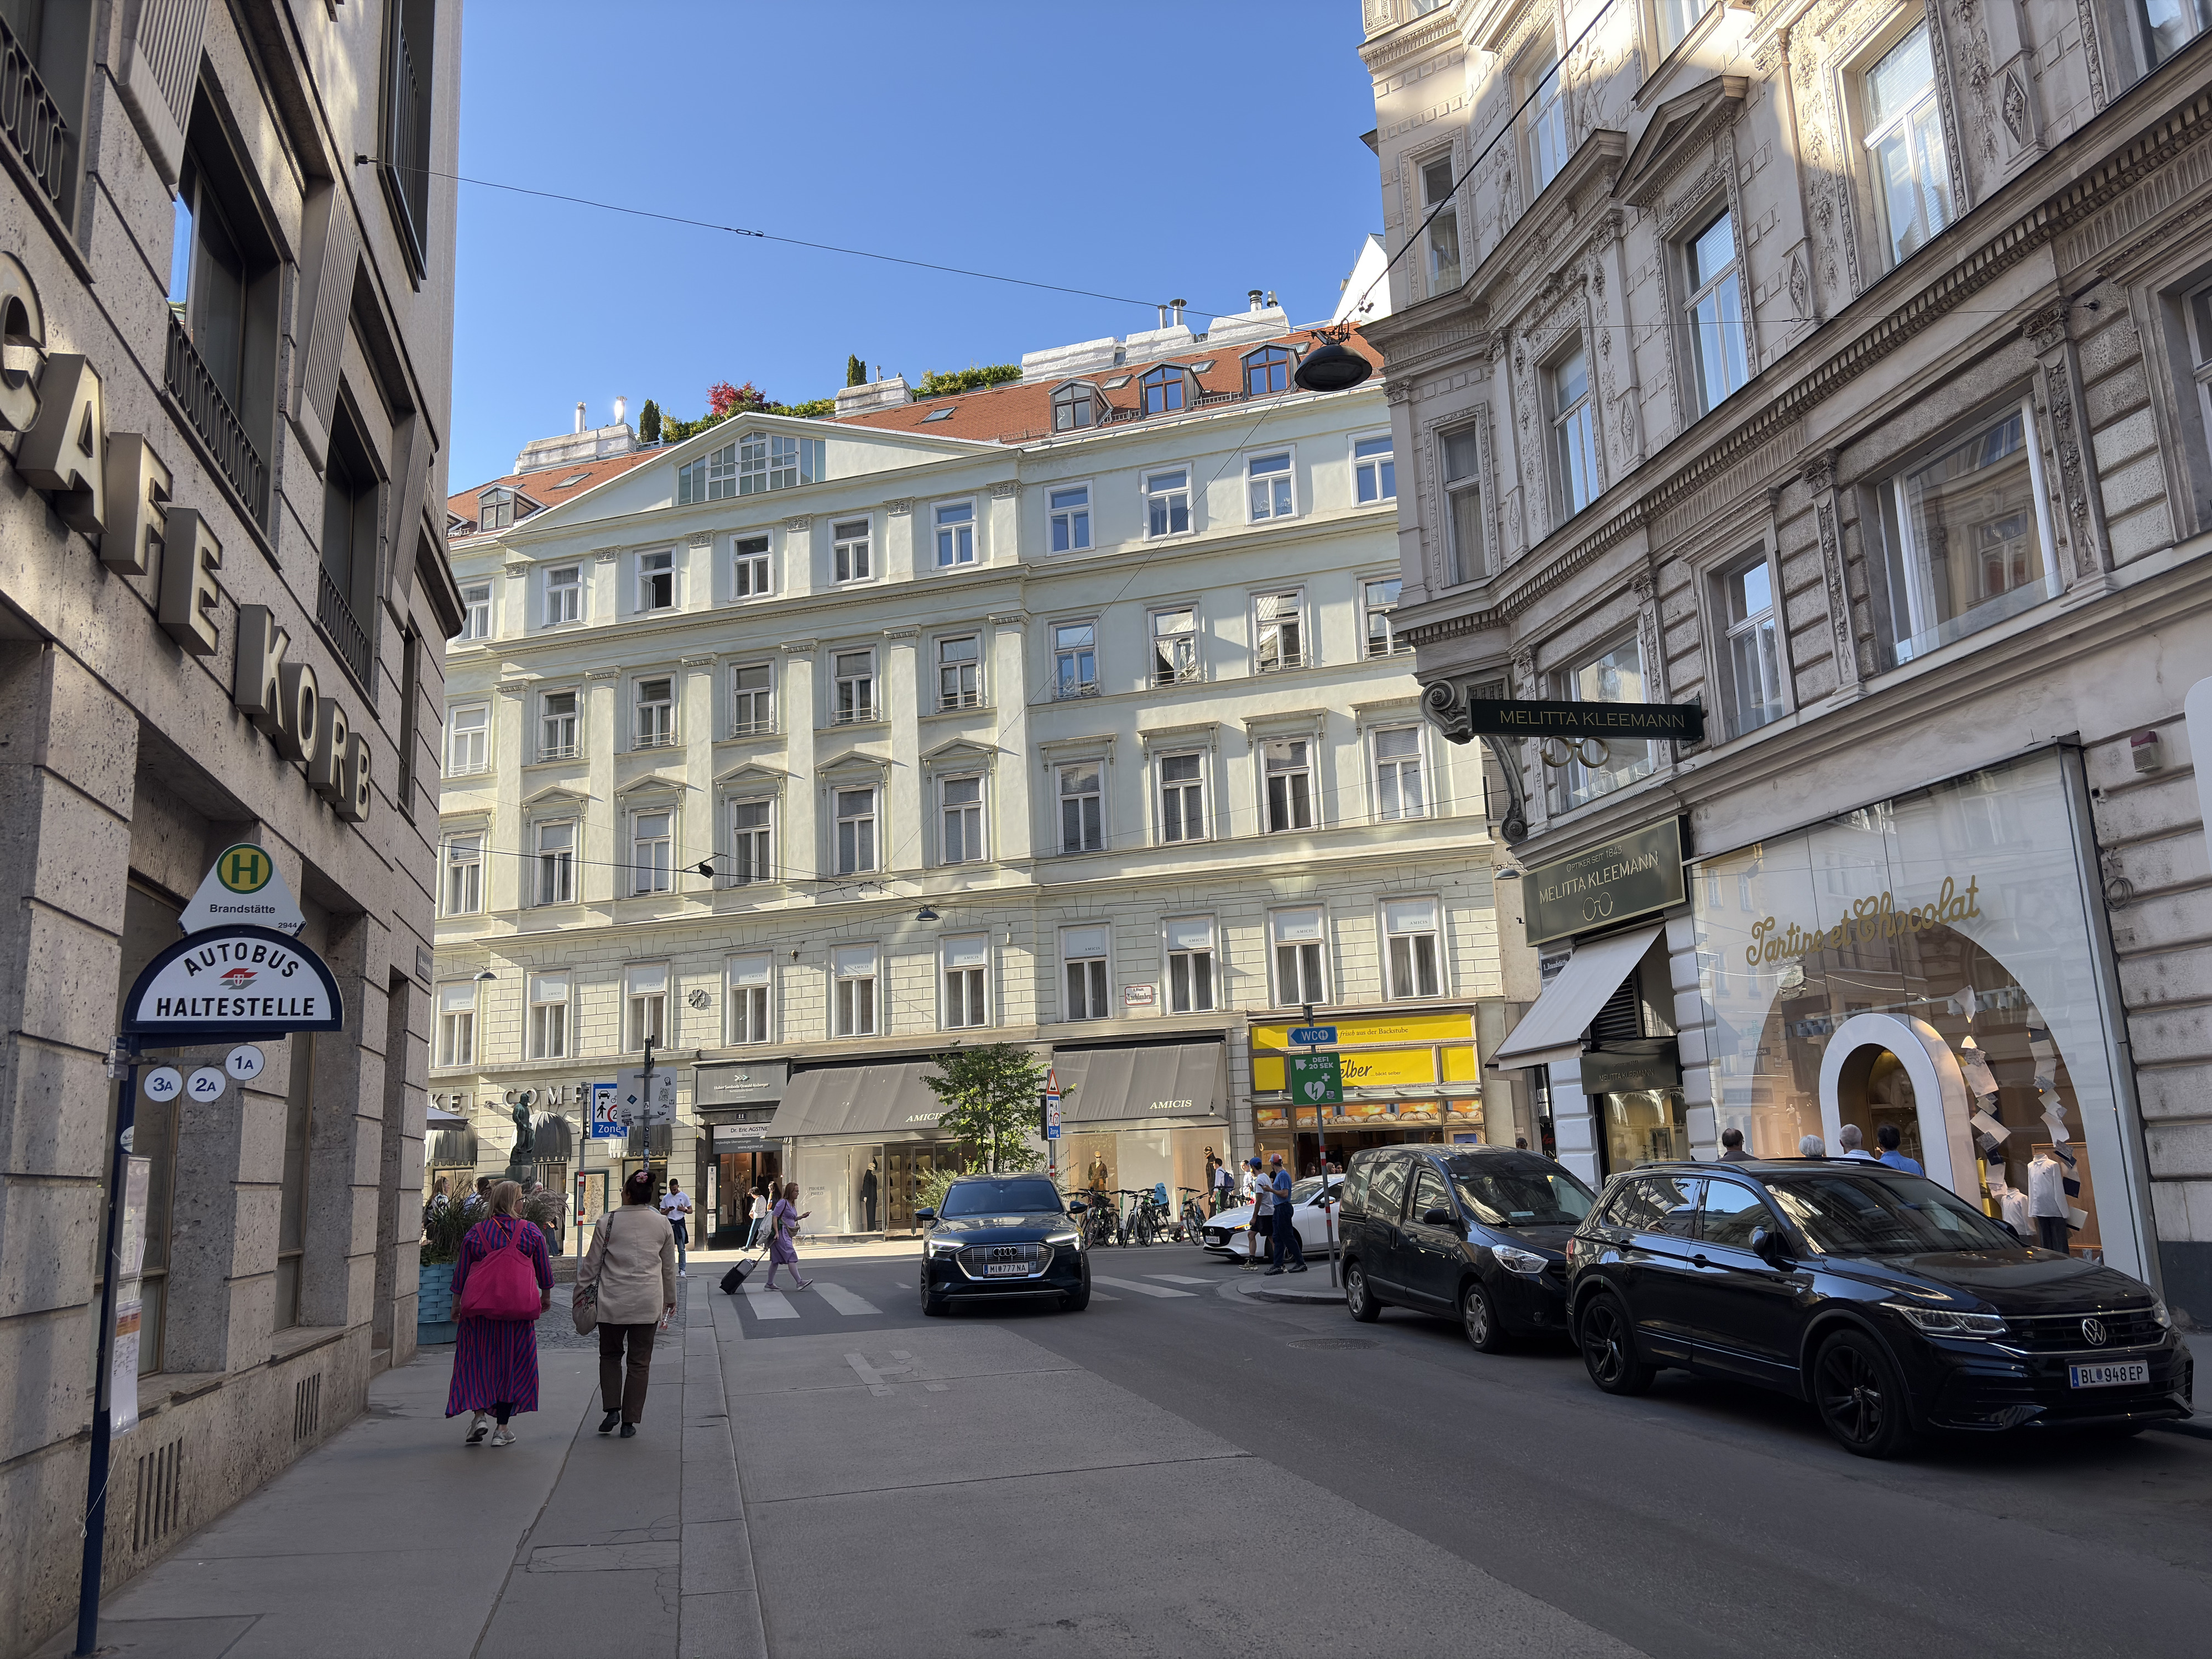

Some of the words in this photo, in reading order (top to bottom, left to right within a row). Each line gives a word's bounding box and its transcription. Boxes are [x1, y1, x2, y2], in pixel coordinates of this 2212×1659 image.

[235, 603, 371, 823] KORB
[1500, 710, 1579, 726] MELITTA
[1582, 712, 1686, 728] KLEEMANN
[1566, 857, 1591, 873] OPTIKER
[1592, 853, 1604, 865] SEIT
[1605, 845, 1623, 859] 1843
[231, 854, 259, 884] H
[1539, 876, 1586, 905] MELITTA
[1588, 850, 1659, 889] KLEEMANN
[210, 904, 275, 914] Brandstätte
[1746, 916, 1824, 966] Tartine
[1830, 909, 1851, 947] et
[1853, 875, 1980, 942] Chocolat
[184, 942, 299, 978] AUTOBUS
[156, 998, 315, 1017] HALTESTELLE
[1301, 1030, 1318, 1041] WC
[1339, 1030, 1355, 1039] frisch
[234, 1056, 254, 1070] 1A
[1340, 1059, 1373, 1079] elber
[1599, 1073, 1622, 1082] MELITTA
[1622, 1068, 1655, 1079] KLEEMANN
[153, 1077, 173, 1092] 3A
[195, 1078, 216, 1092] 2A
[484, 1100, 493, 1109] &
[1149, 1099, 1192, 1110] AMICIS
[905, 1112, 946, 1123] AMICIS
[598, 1124, 621, 1133] Zone
[2081, 1369, 2096, 1384] BL
[2104, 1366, 2127, 1383] 948
[2128, 1365, 2143, 1381] EP
